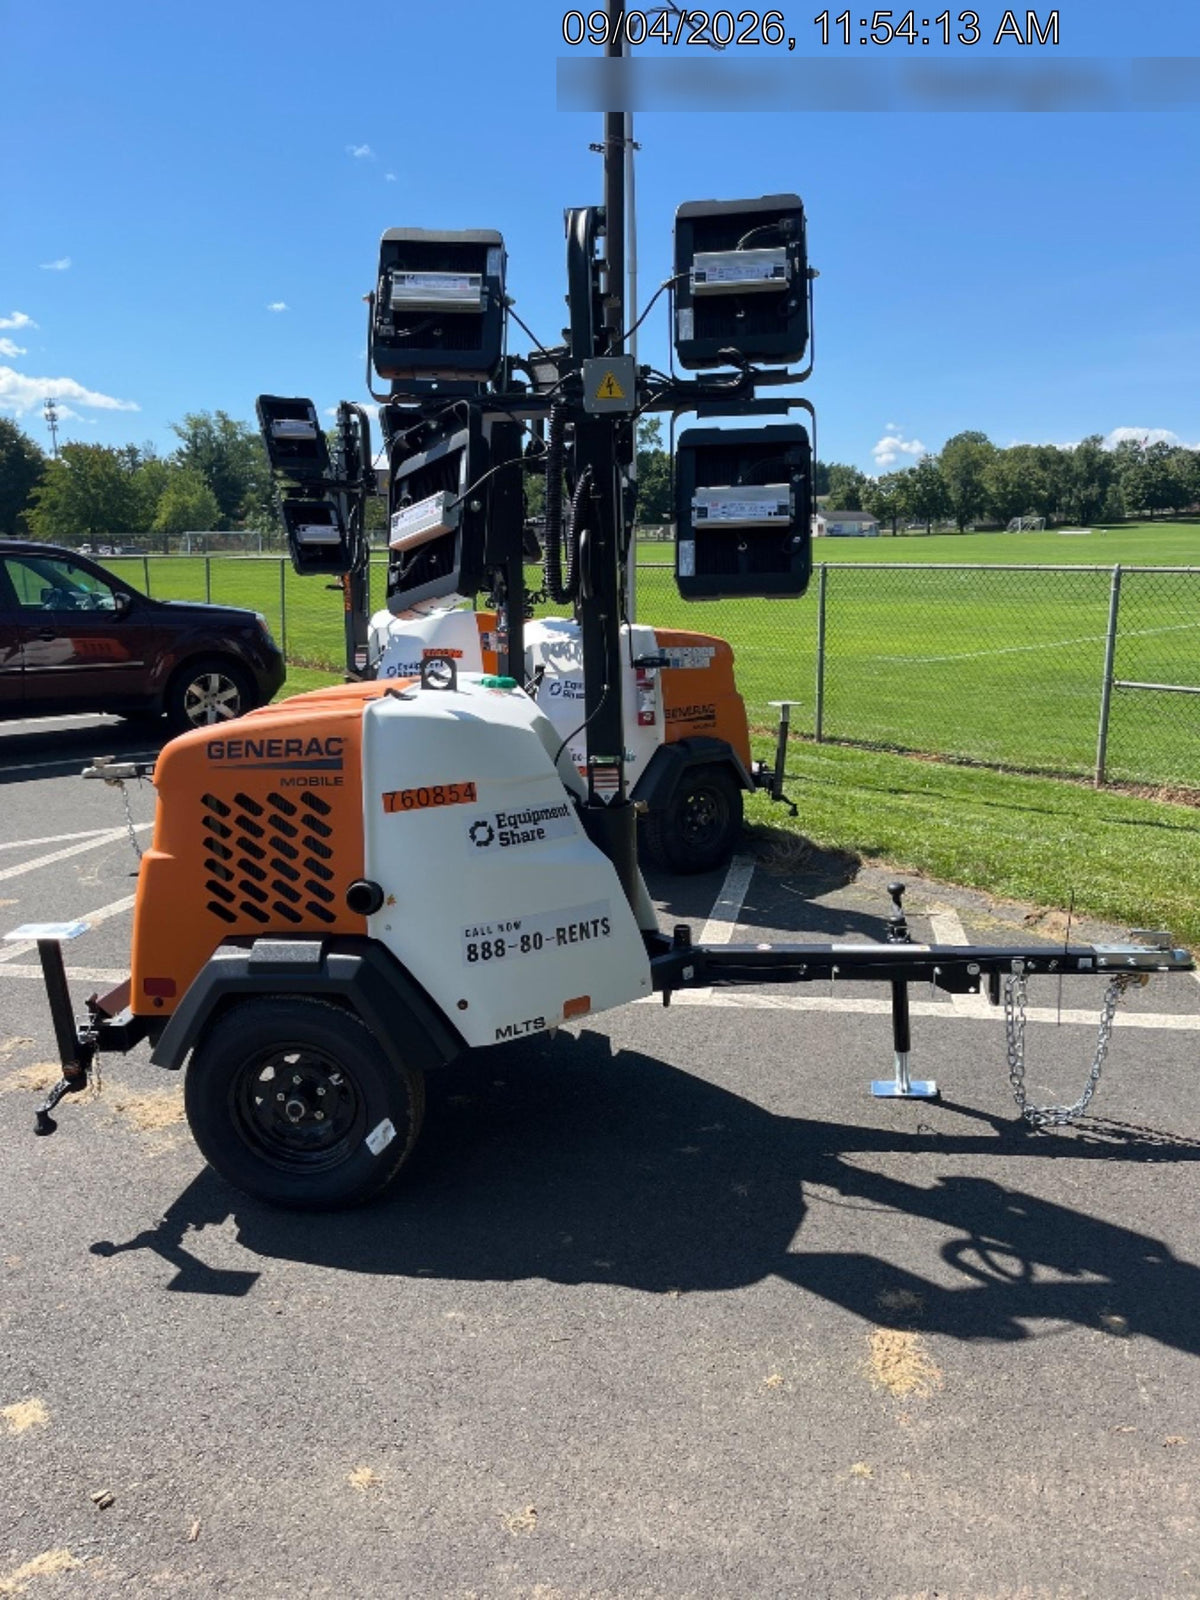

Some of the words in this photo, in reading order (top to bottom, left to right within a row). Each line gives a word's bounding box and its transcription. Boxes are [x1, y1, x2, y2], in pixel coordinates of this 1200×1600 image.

[207, 737, 344, 760] GENERAC
[280, 776, 344, 787] MOBILE
[387, 782, 476, 812] 760854
[495, 803, 571, 829] Equipment
[498, 827, 546, 848] Share
[465, 926, 494, 938] CALL
[497, 920, 522, 932] NOW
[466, 917, 611, 963] 888-80-RENTS
[495, 1016, 546, 1041] MLTS
